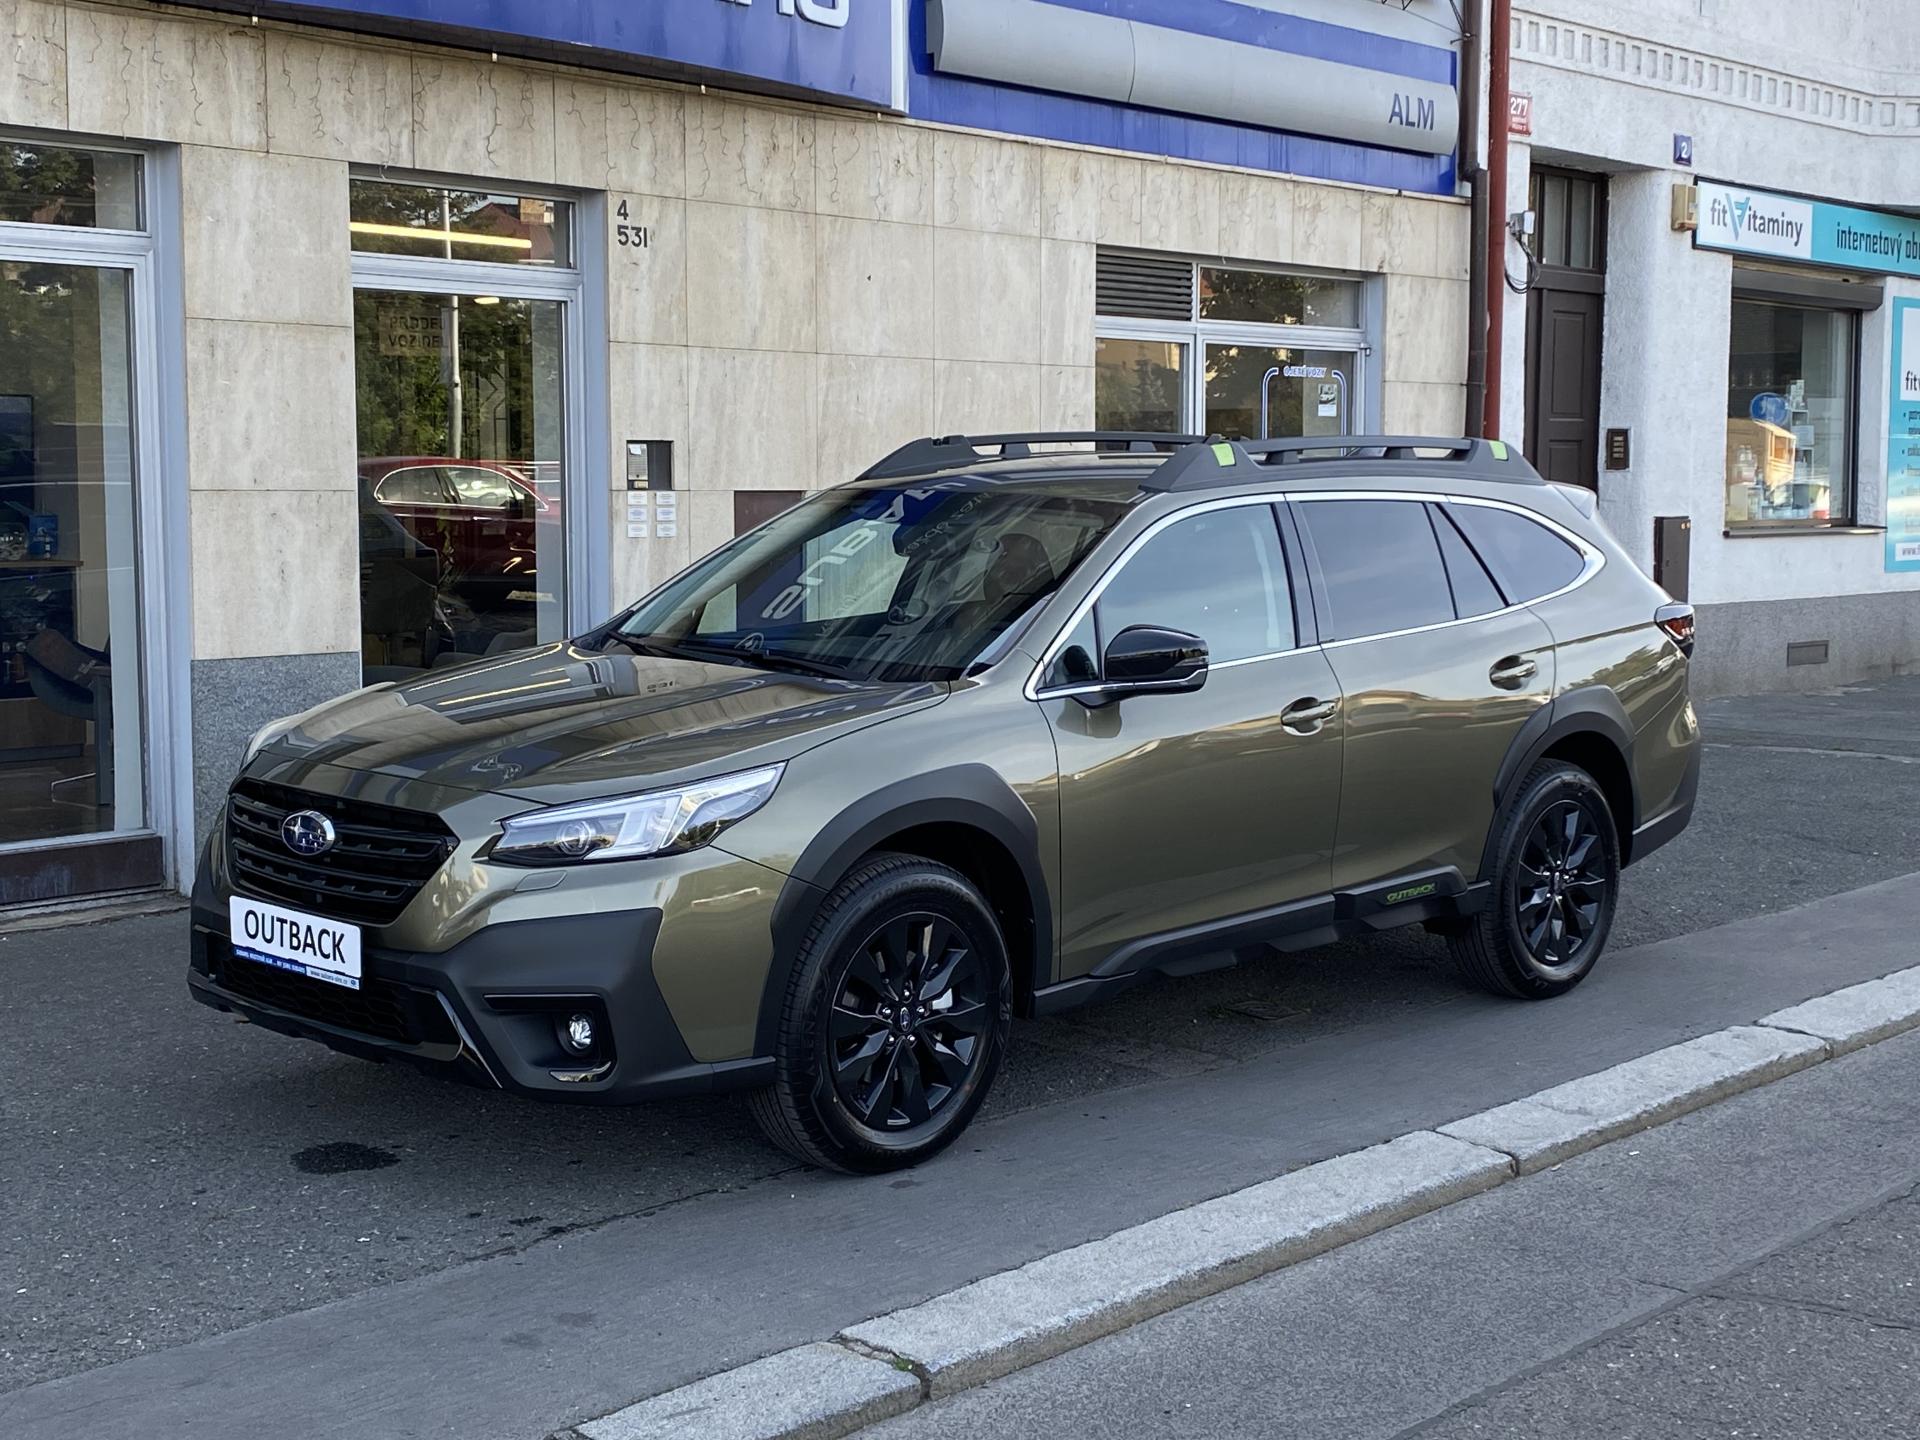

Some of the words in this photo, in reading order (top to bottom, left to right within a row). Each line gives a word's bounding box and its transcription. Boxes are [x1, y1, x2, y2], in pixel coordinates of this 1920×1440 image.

[1388, 93, 1434, 131] ALM
[1510, 96, 1529, 116] 277
[1681, 142, 1689, 159] 2
[616, 199, 629, 221] 4
[617, 224, 648, 248] 531
[1836, 221, 1903, 264] internetový
[1905, 231, 1920, 260] ob
[1905, 370, 1920, 391] fit
[1386, 882, 1436, 903] OUTBACK
[243, 908, 346, 965] OUTBACK
